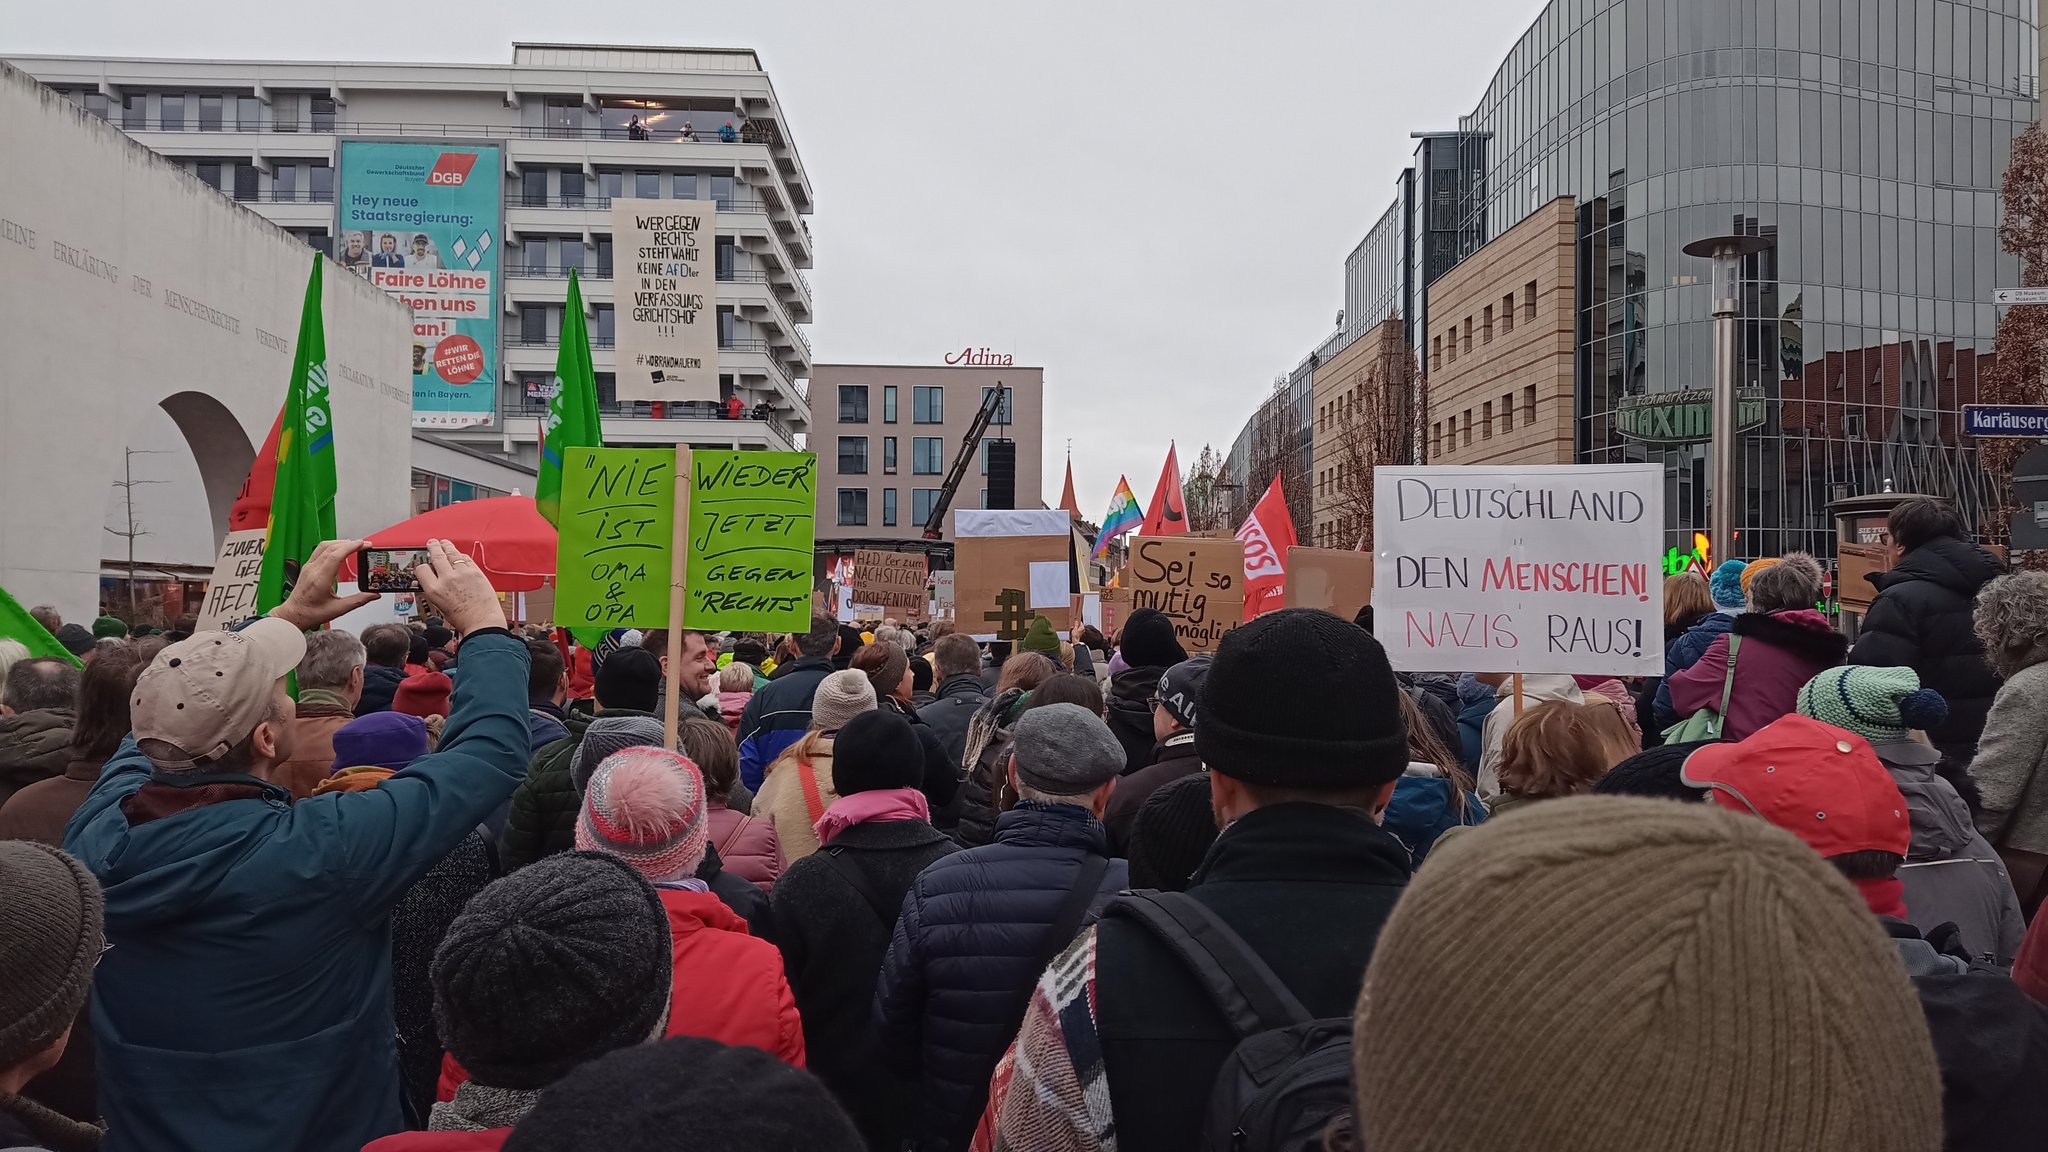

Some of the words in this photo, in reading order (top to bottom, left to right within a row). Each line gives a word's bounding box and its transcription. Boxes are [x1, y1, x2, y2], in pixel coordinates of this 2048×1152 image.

[432, 172, 463, 184] DGB
[351, 194, 379, 208] Hey
[383, 196, 419, 207] neue
[351, 209, 474, 227] Staatsregierung:
[636, 216, 663, 231] WER
[665, 215, 701, 231] GEGEN
[654, 231, 696, 247] RECHTS
[639, 247, 670, 259] STEHT
[671, 247, 700, 262] WÄHLT
[637, 262, 663, 276] KEINE
[665, 263, 700, 278] AfDler
[375, 271, 424, 287] Faire
[428, 272, 486, 289] Löhne
[641, 278, 650, 290] IN
[655, 279, 677, 291] DEN
[53, 240, 118, 284] ERKLÄRUNG
[132, 274, 152, 298] DER
[164, 288, 240, 335] MENSCHENRECHTE
[255, 327, 288, 354] VEREINTE
[441, 298, 476, 312] uns
[634, 291, 704, 310] VERFASSUNGS
[632, 307, 697, 325] GERICHTSHOF
[413, 321, 446, 336] an!
[436, 353, 466, 368] RETTEN
[467, 350, 481, 361] DIE
[444, 344, 468, 356] #WIR
[945, 347, 1014, 366] Adina
[447, 362, 475, 376] LÖHNE
[428, 390, 436, 398] in
[438, 391, 471, 400] Bayern.
[1619, 401, 1761, 438] MAXIMM
[1396, 478, 1644, 523] DEUTSCHLAND
[696, 511, 812, 551] JETZT
[591, 561, 647, 582] OMA
[706, 564, 806, 582] GEGEN
[902, 560, 924, 568] zum
[1132, 541, 1197, 588] Sei
[1205, 572, 1232, 591] so
[854, 566, 921, 586] NACHSITZEN
[1396, 555, 1468, 589] DEN
[1481, 556, 1649, 602] MENSCHEN!
[605, 581, 626, 602] &
[852, 590, 922, 608] DOKU-ZENTRUM
[694, 588, 809, 614] "RECHTS"
[1132, 586, 1207, 622] mutig
[585, 603, 635, 623] OPA
[1406, 610, 1518, 649] NAZIS
[1548, 614, 1642, 657] RAUS!
